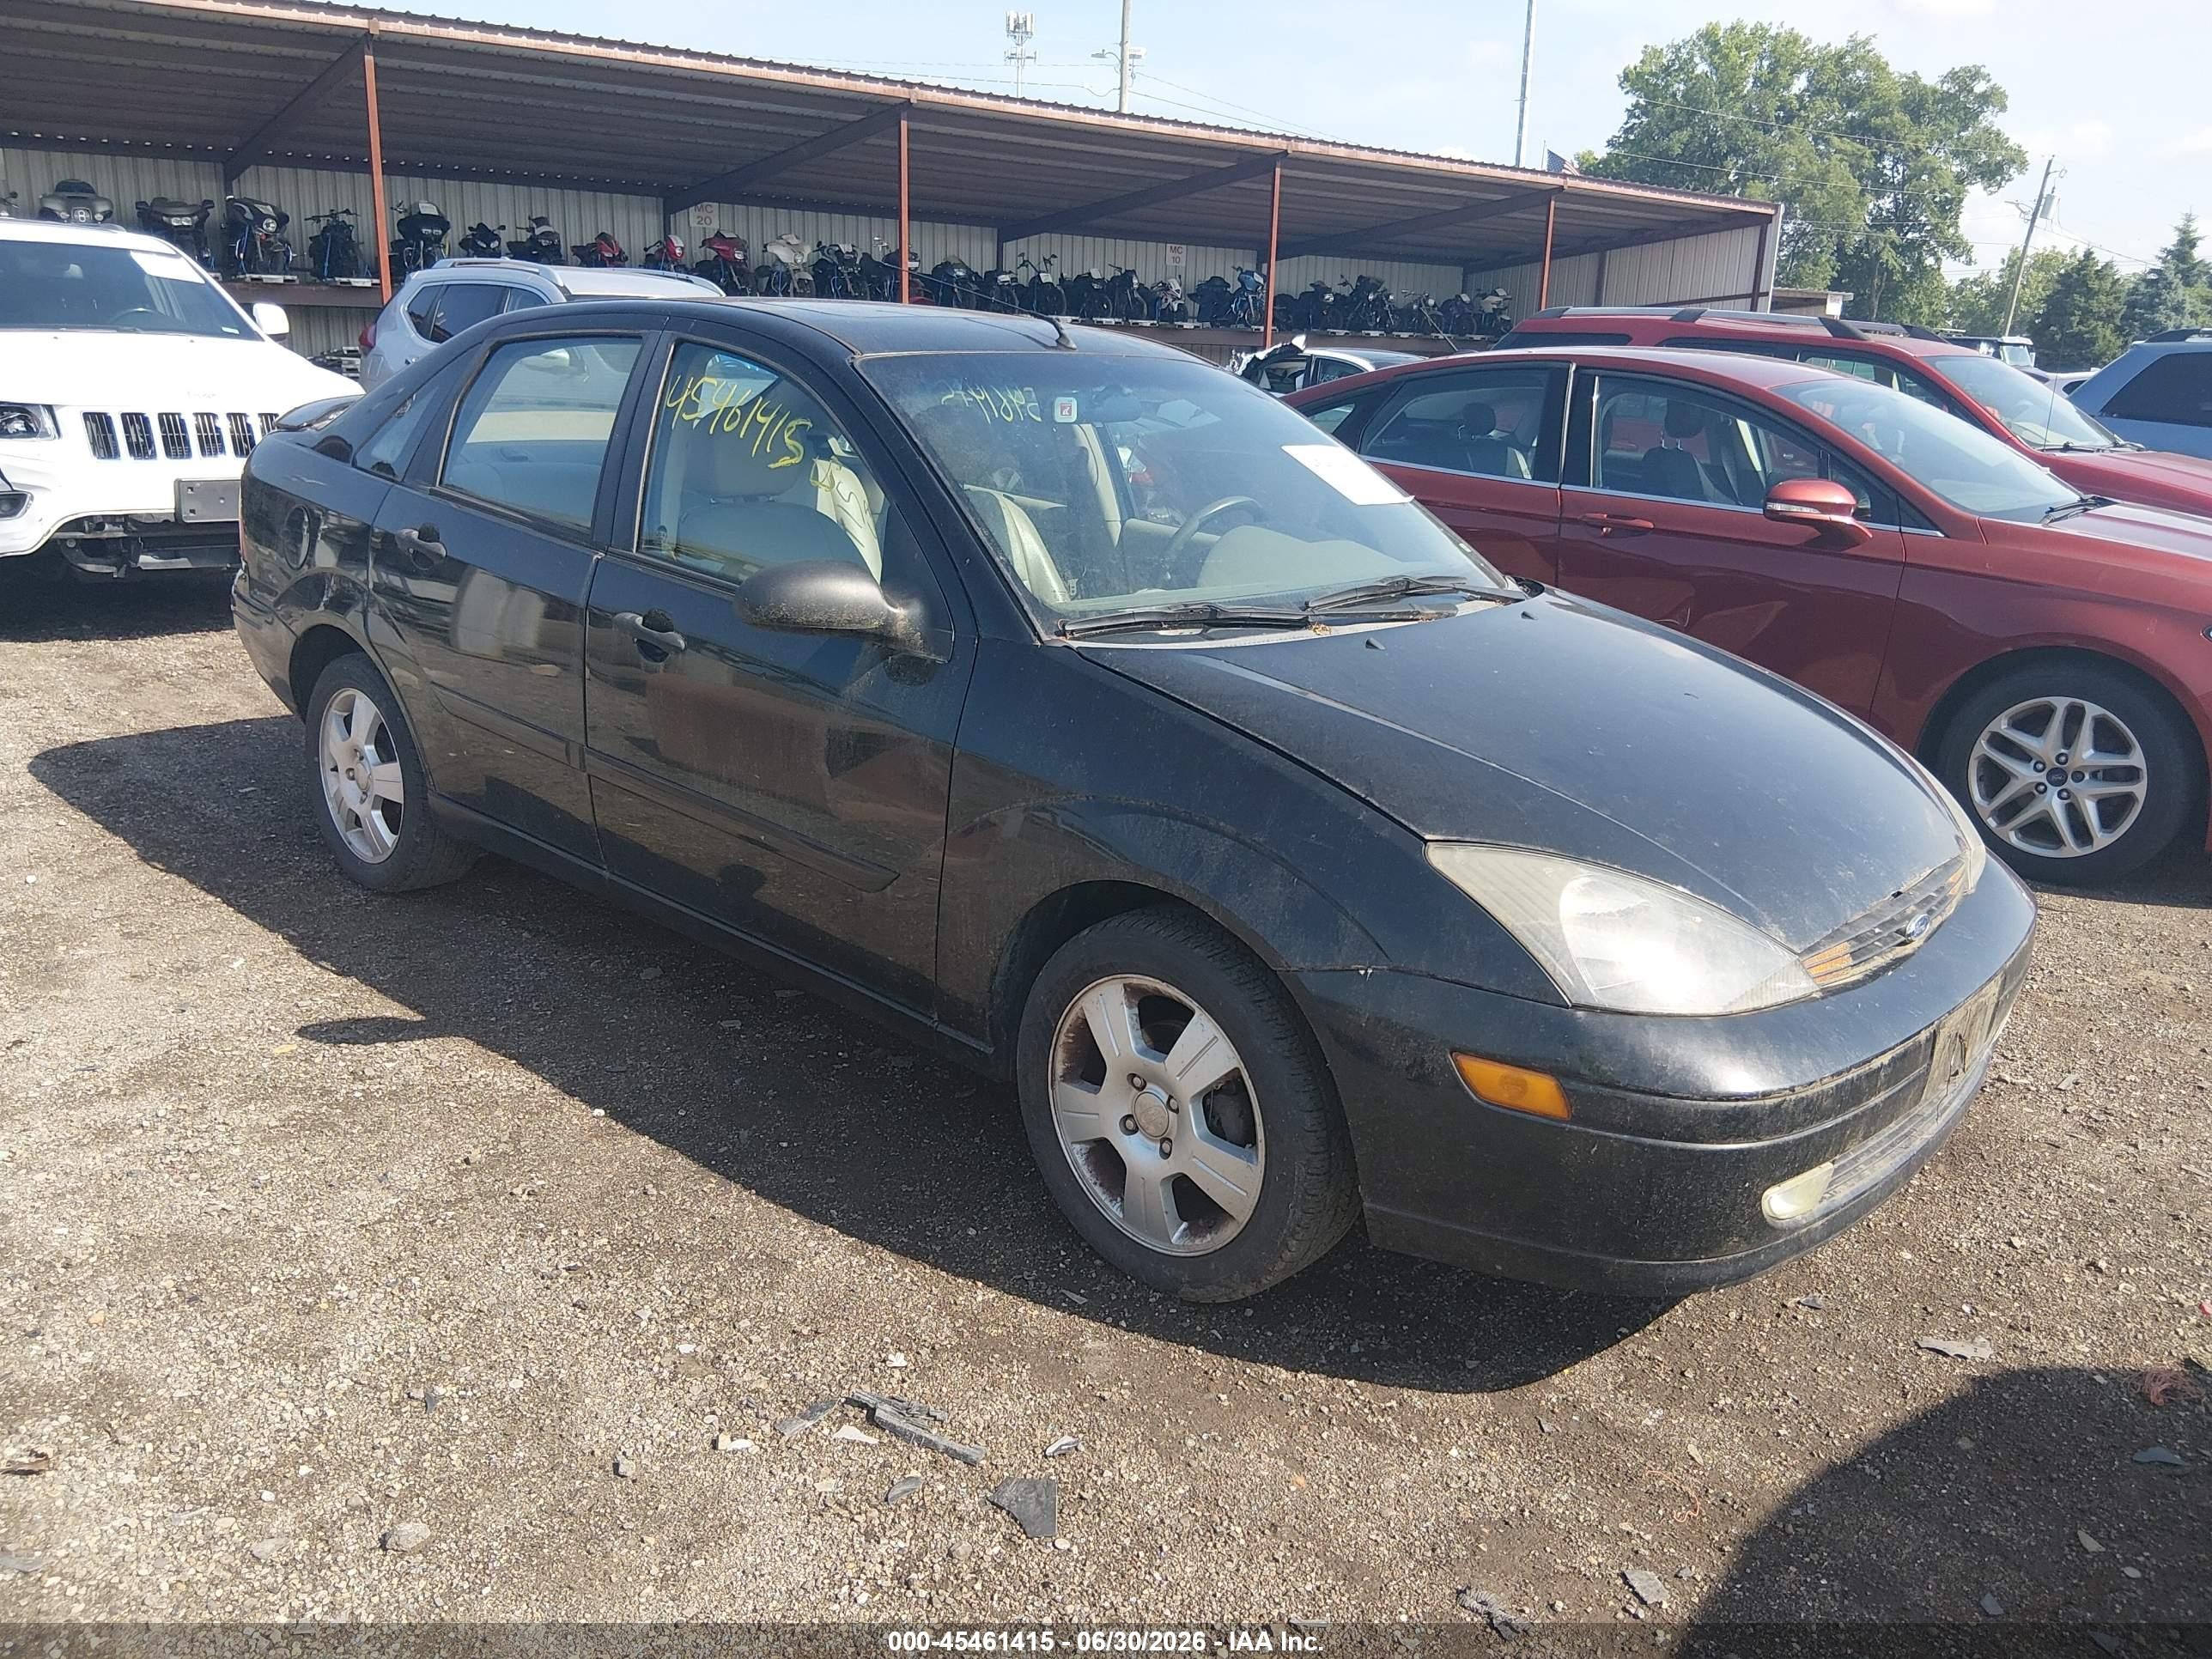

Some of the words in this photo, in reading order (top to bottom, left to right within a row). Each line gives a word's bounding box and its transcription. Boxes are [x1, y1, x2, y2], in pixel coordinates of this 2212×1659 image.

[694, 204, 714, 214] MC
[696, 216, 713, 226] 20
[1169, 245, 1183, 255] MC
[1171, 256, 1181, 264] 10
[666, 374, 813, 469] 45461415
